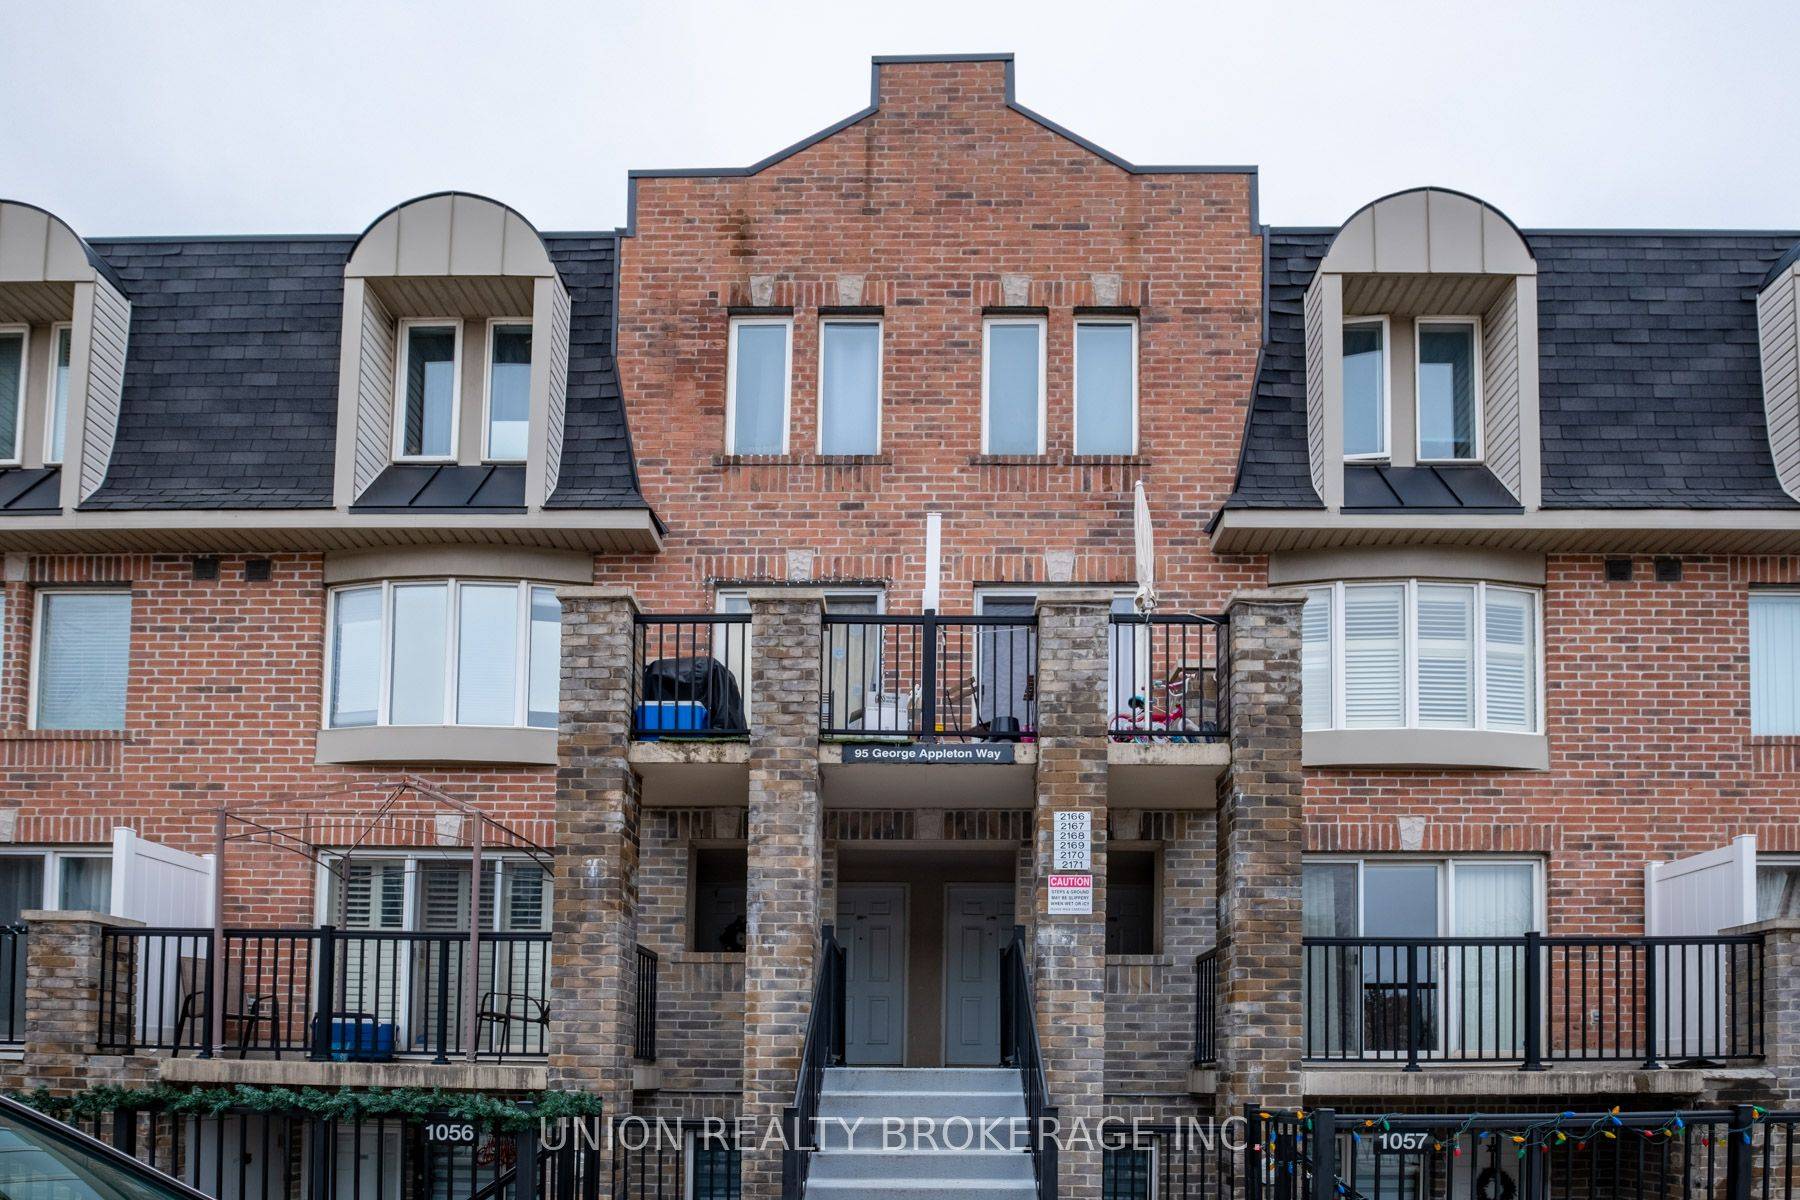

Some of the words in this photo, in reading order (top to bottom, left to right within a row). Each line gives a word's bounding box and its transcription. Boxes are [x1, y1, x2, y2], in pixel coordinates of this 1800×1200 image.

[854, 749, 869, 758] 95
[872, 749, 916, 760] George
[919, 749, 972, 760] Appleton
[976, 749, 1001, 760] Way
[1060, 812, 1085, 820] 2166
[1060, 822, 1085, 830] 2167
[1060, 832, 1085, 840] 2168
[1060, 841, 1085, 849] 2169
[1060, 851, 1085, 859] 2170
[1062, 861, 1083, 869] 2171
[1050, 877, 1090, 886] CAUTION
[425, 1124, 474, 1140] 1056
[1379, 1133, 1428, 1150] 1057
